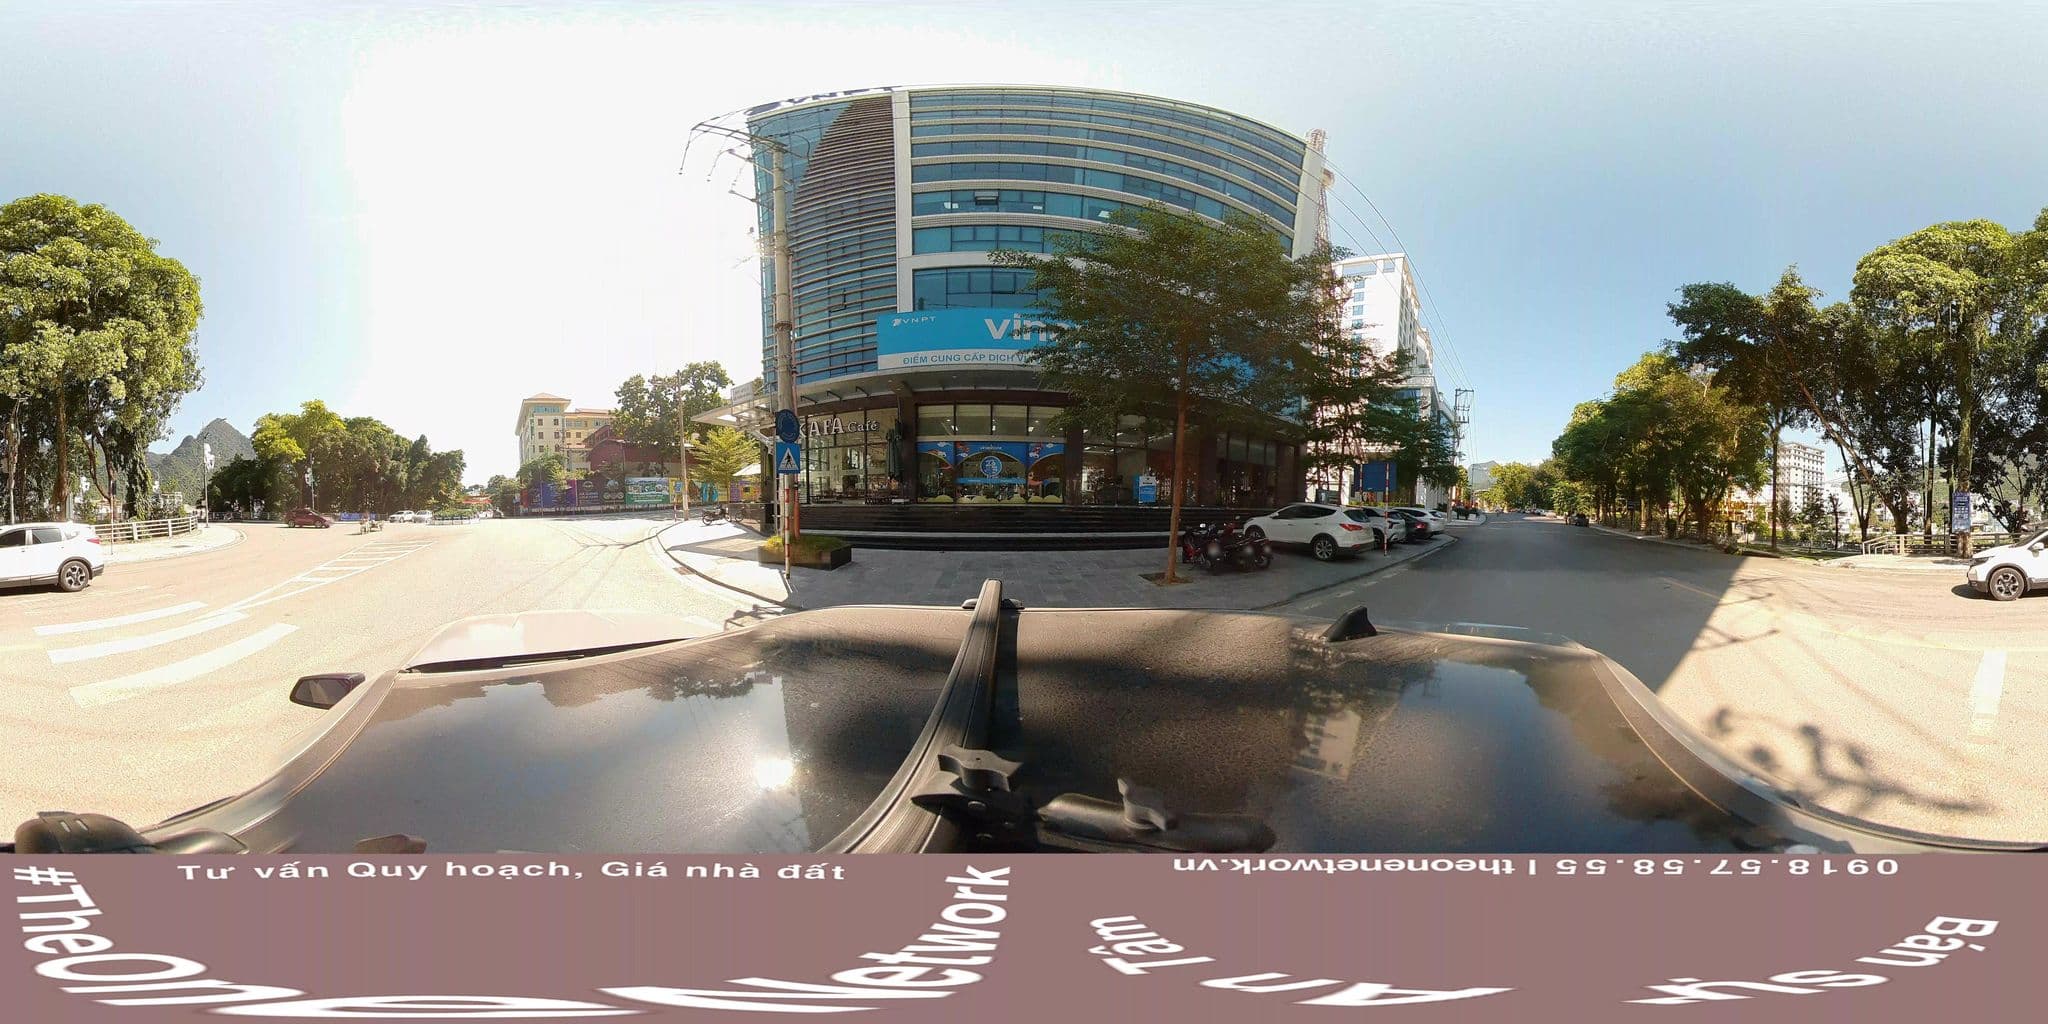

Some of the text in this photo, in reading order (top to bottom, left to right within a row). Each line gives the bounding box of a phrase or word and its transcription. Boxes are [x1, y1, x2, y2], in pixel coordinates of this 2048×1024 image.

[902, 315, 936, 325] VNPT
[931, 354, 961, 363] CUNG
[847, 419, 878, 433] Café
